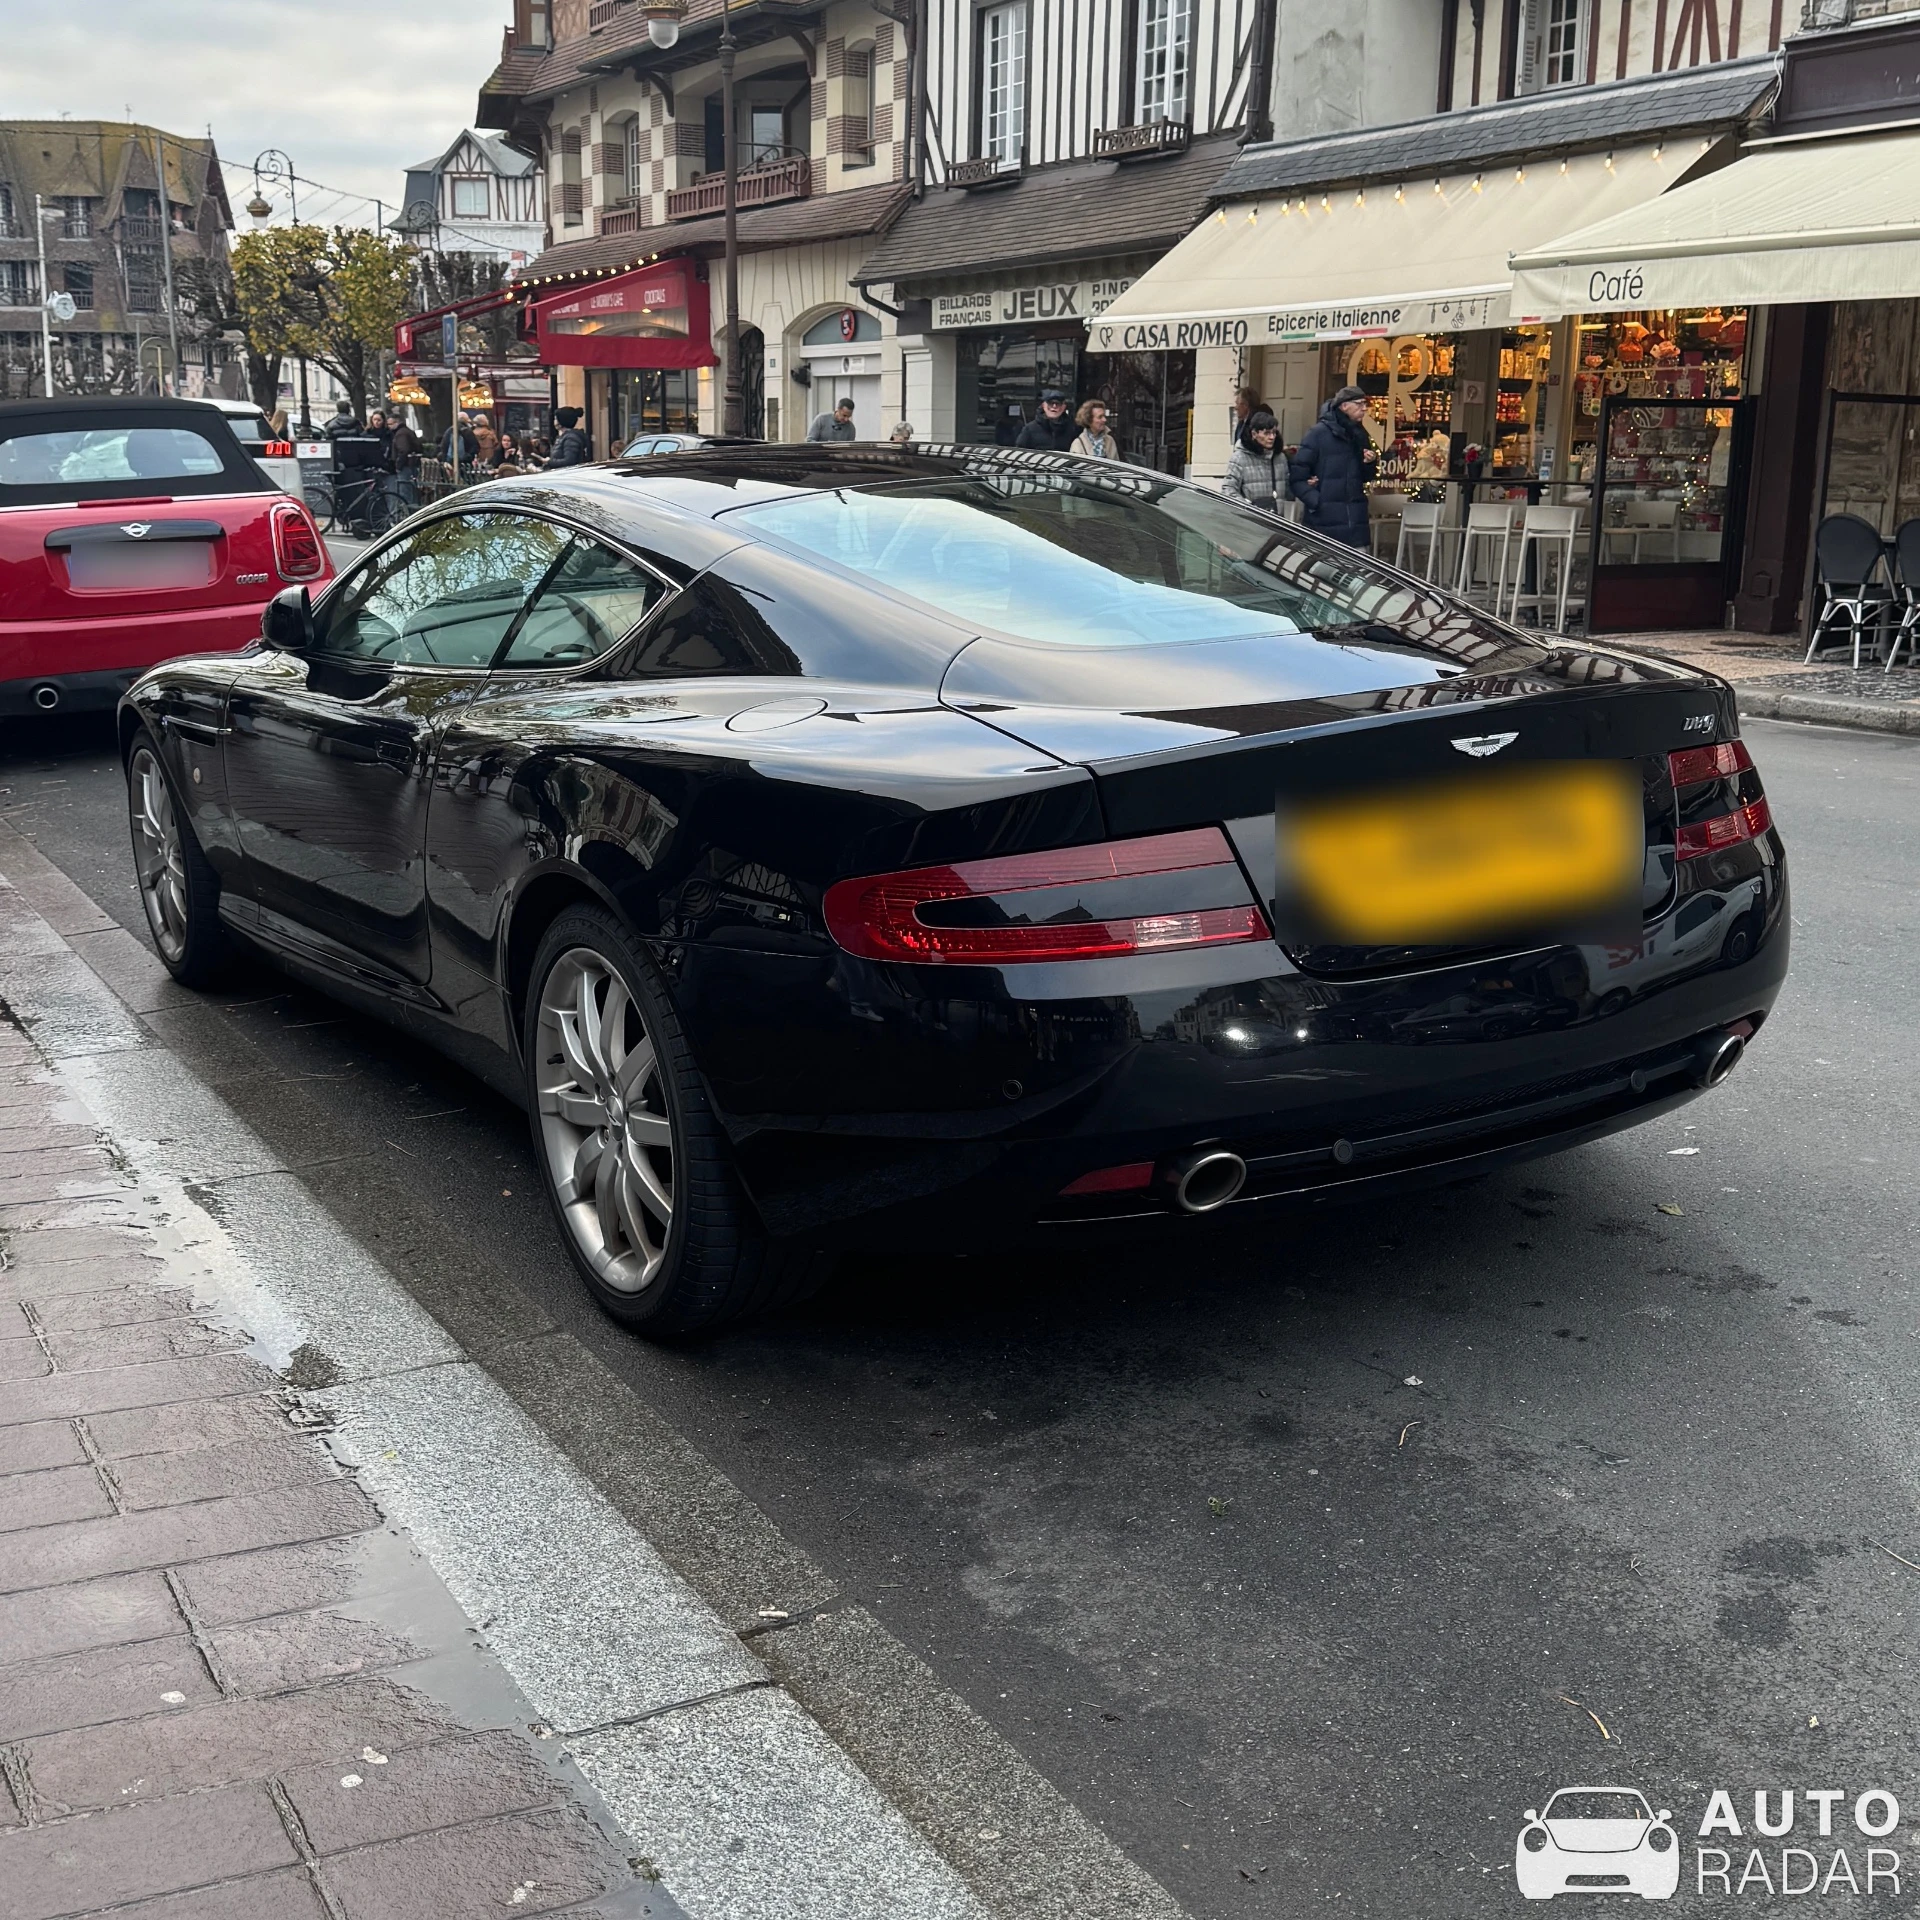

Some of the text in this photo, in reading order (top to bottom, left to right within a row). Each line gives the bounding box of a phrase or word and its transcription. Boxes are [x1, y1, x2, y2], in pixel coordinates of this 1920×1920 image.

[1092, 281, 1130, 296] PING
[1588, 266, 1644, 302] Café
[939, 295, 992, 311] BILLARDS
[1003, 285, 1078, 320] JEUX
[1092, 299, 1115, 312] PO
[939, 310, 992, 326] FRANÇAIS
[1268, 307, 1402, 335] Epicerie Italienne
[1124, 324, 1170, 349] CASA
[1176, 320, 1248, 347] ROMEO
[236, 572, 269, 584] COOPER
[1683, 713, 1716, 734] DB9
